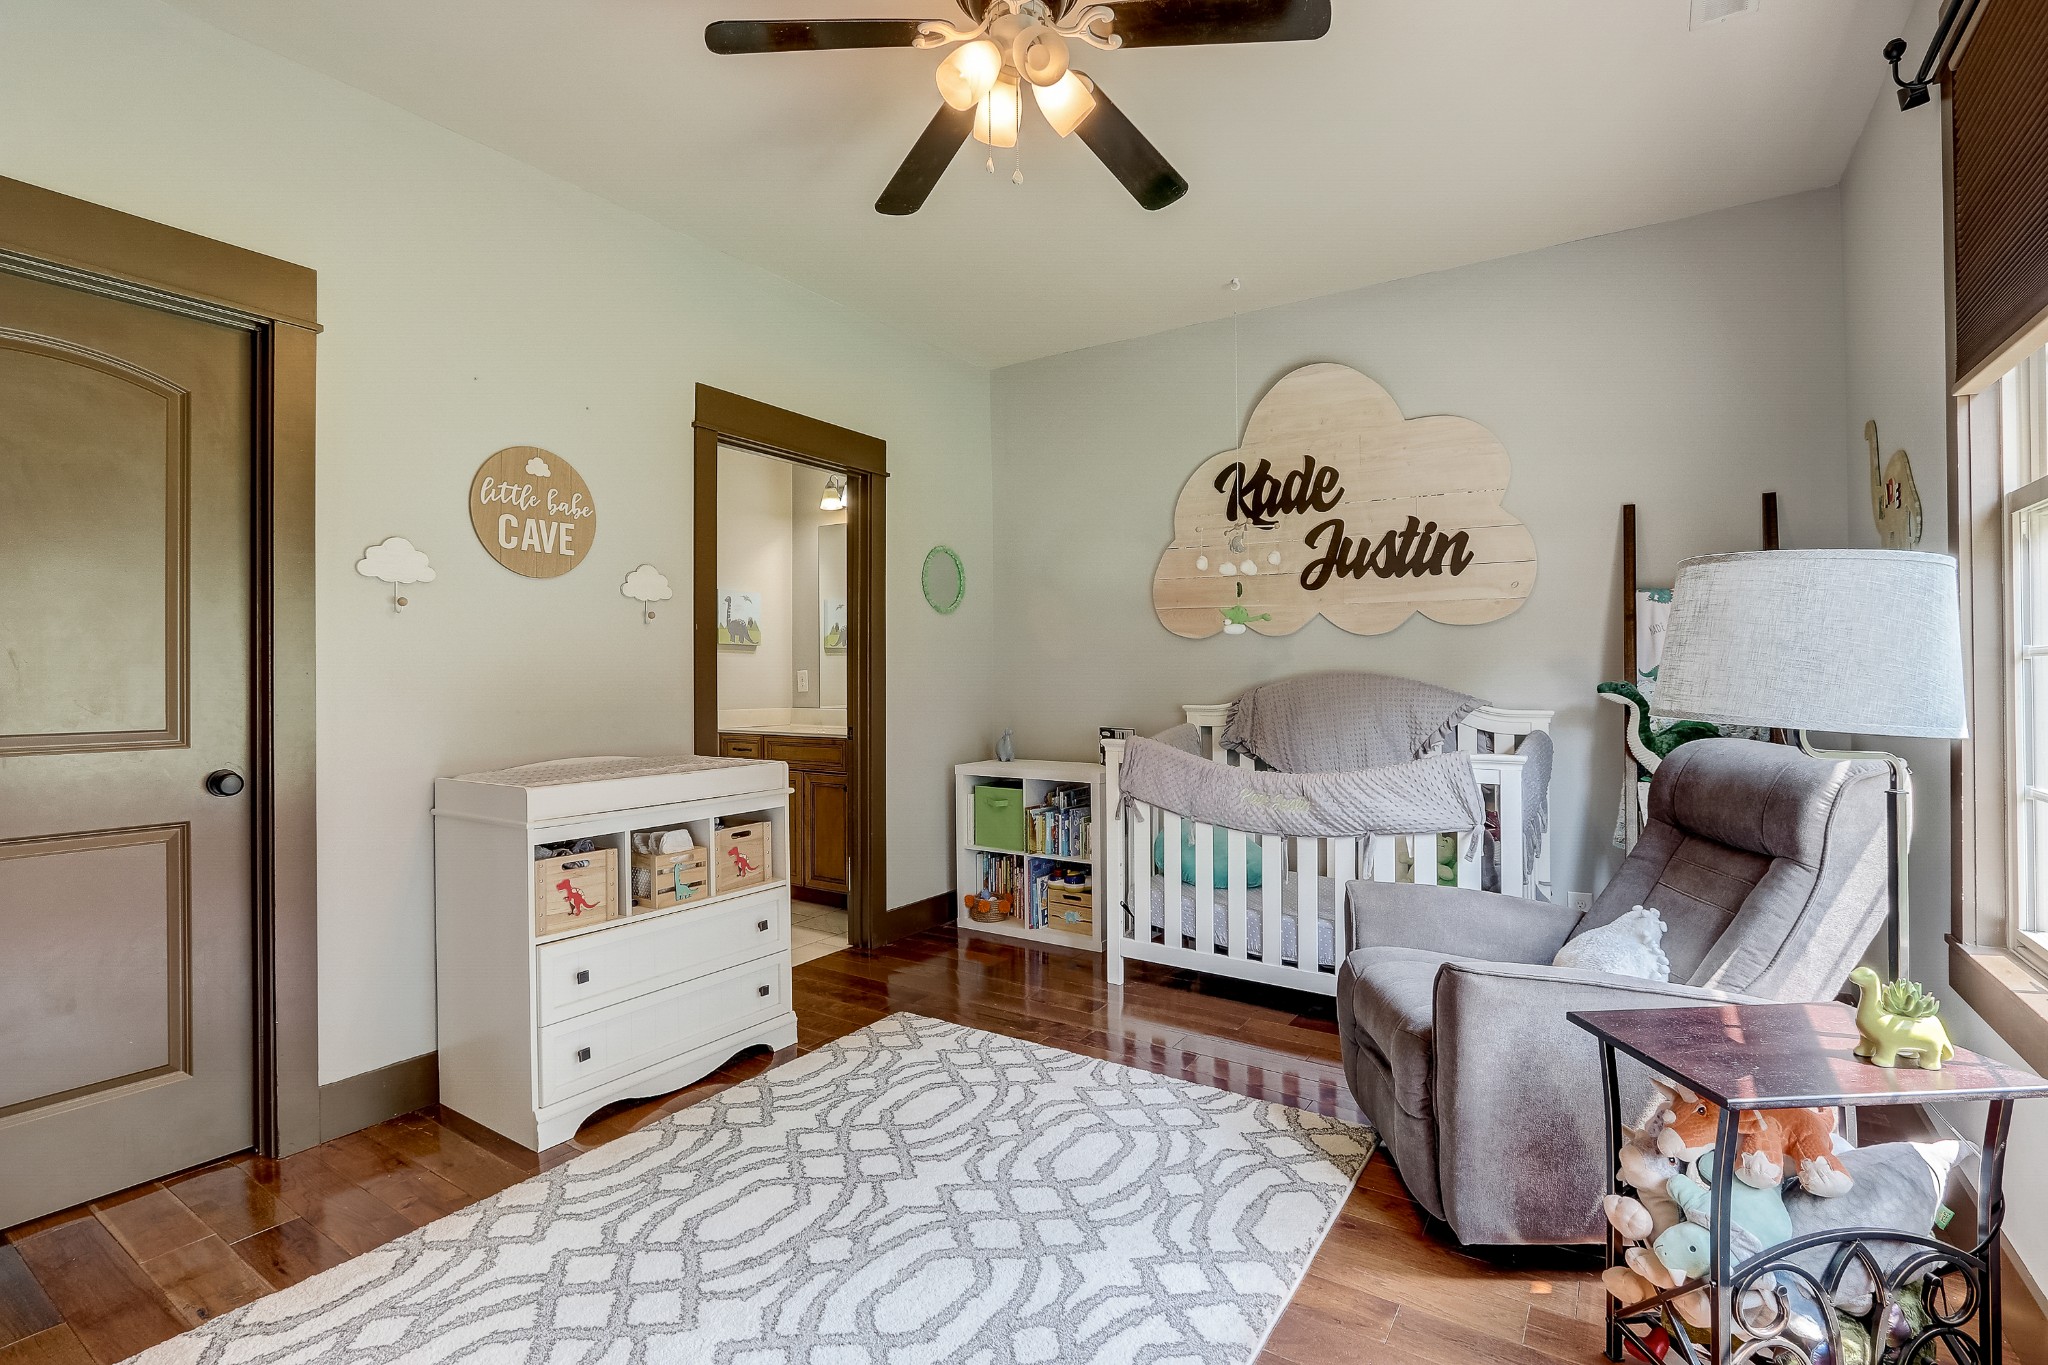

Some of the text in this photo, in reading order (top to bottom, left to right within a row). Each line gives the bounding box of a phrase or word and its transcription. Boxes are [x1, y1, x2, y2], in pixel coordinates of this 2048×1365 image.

[480, 477, 594, 520] little babe
[1214, 455, 1345, 530] Kade
[498, 513, 575, 556] CAVE
[1300, 515, 1474, 591] Justin
